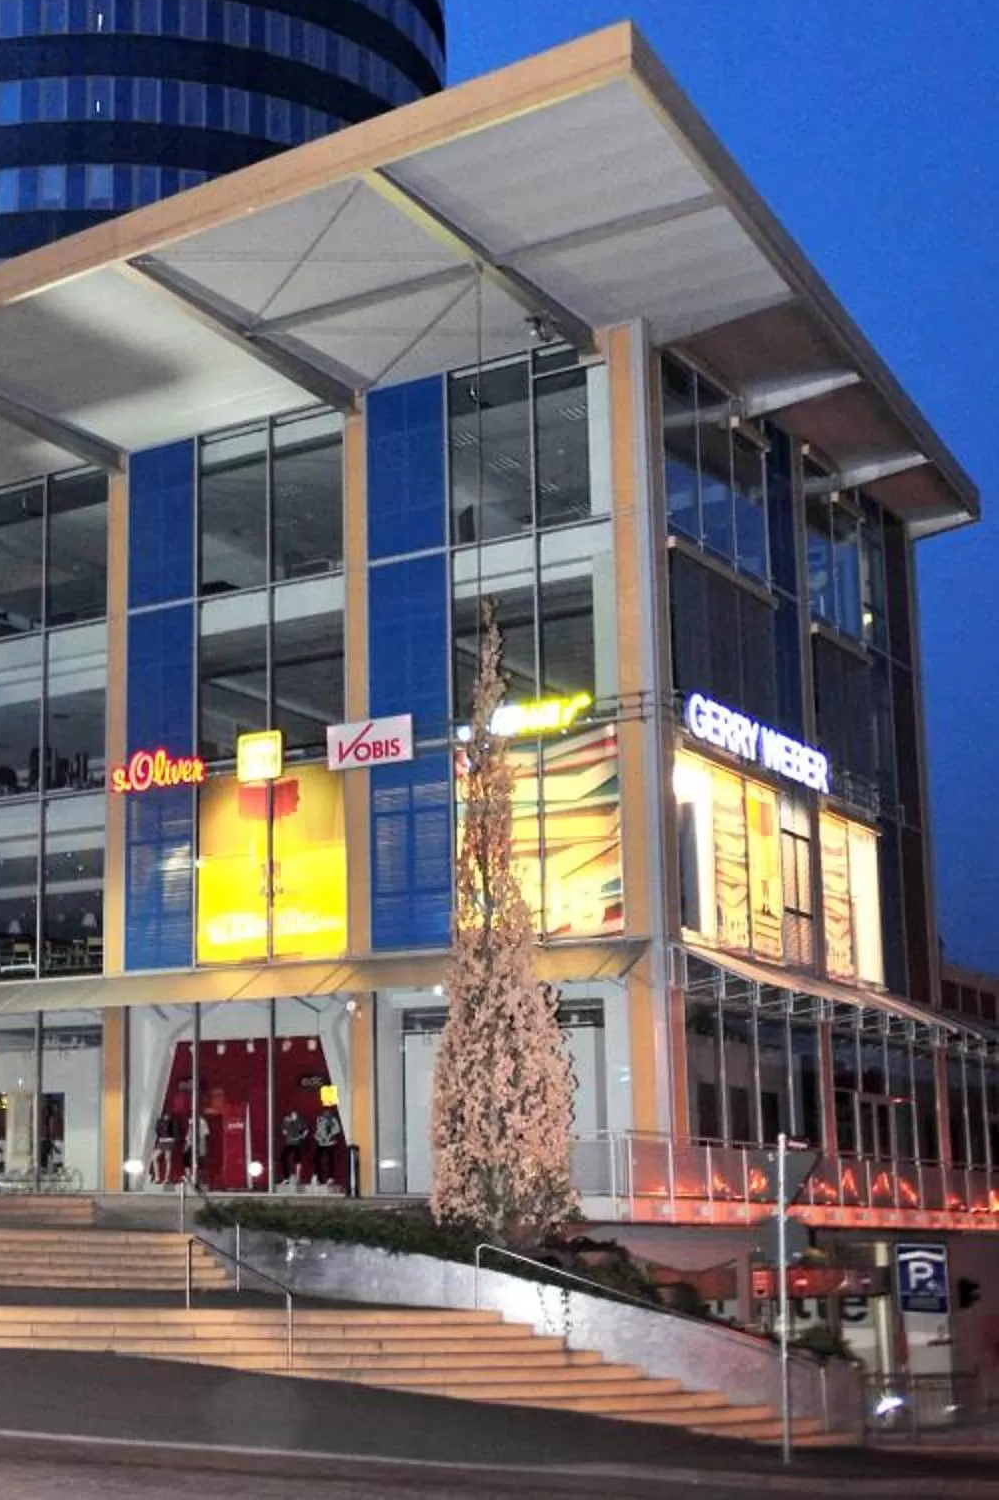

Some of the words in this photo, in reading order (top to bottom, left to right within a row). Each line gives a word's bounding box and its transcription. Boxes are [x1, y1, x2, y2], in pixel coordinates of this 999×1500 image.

[337, 722, 401, 762] VOBIS
[689, 693, 760, 761] GERRY
[761, 726, 830, 794] WEBER
[112, 749, 204, 792] s.Oliver
[908, 1261, 934, 1289] P
